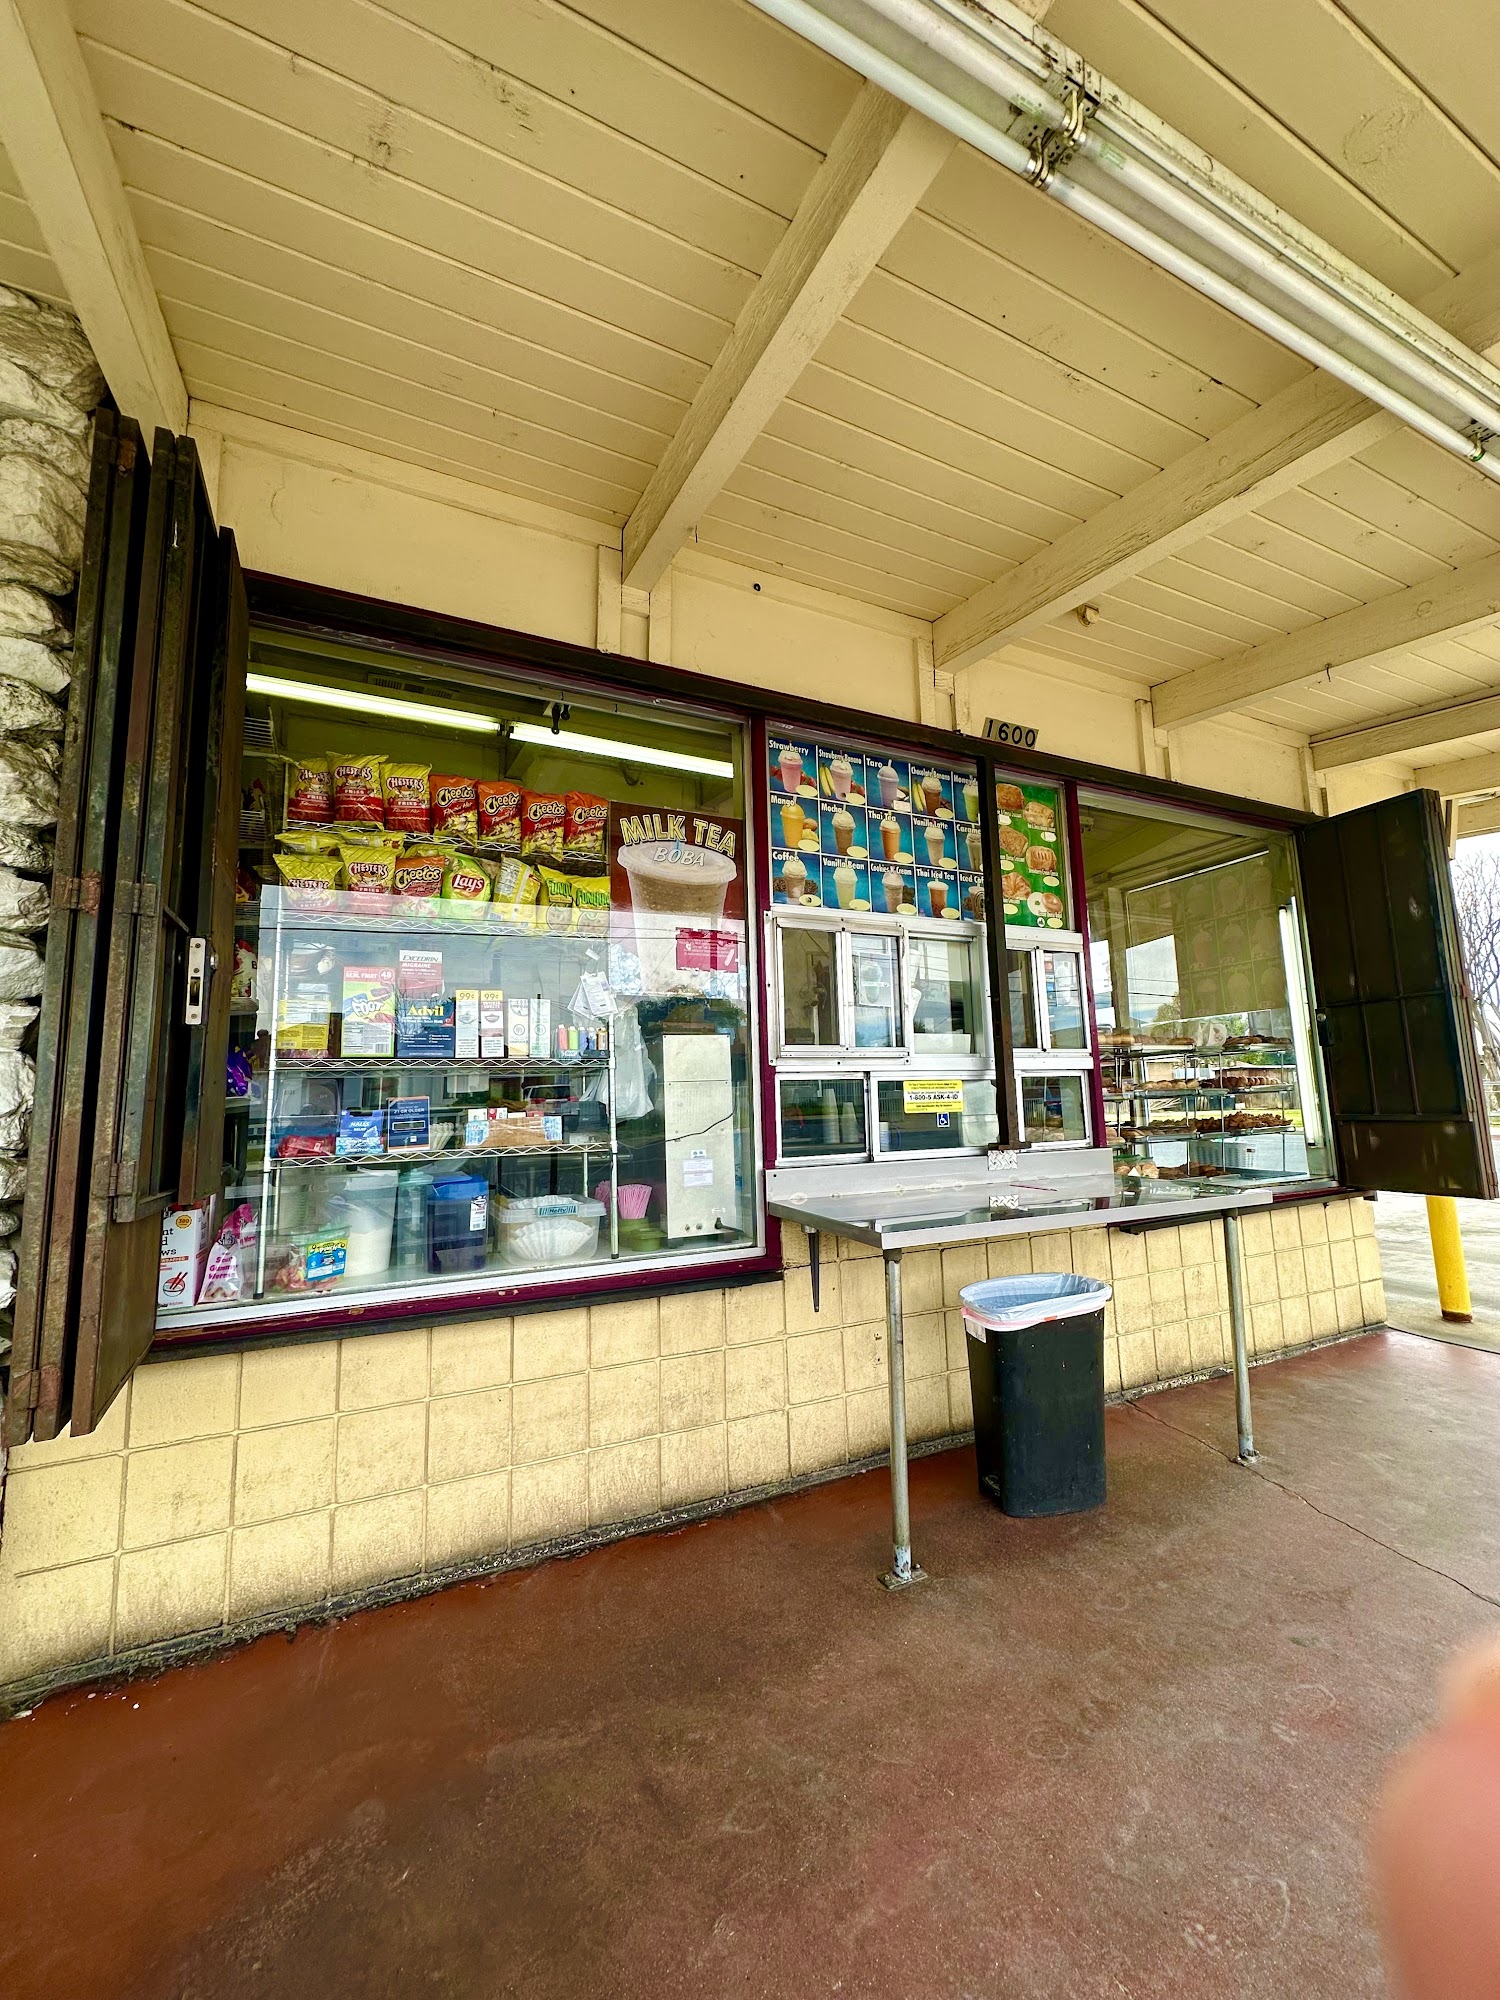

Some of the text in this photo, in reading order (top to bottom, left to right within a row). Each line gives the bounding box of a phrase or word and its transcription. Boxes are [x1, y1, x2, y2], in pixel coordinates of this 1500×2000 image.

[986, 719, 1036, 749] 1600
[769, 740, 809, 756] Strawberry
[866, 758, 883, 769] Taro
[386, 776, 425, 794] CHESTER'S
[436, 785, 476, 807] Cheetos
[771, 795, 795, 807] Mango
[527, 801, 566, 823] Cheetos
[821, 803, 843, 813] Mocha
[573, 806, 608, 825] Cheetos
[869, 811, 884, 820] Thai
[913, 818, 949, 830] Vanilla Latte
[956, 824, 981, 835] Carame
[619, 813, 737, 860] MILK TEA
[653, 845, 706, 868] BOBA
[772, 851, 800, 862] Coffee
[822, 857, 865, 870] Vanilla Bean
[348, 862, 390, 881] CHESTER'S
[394, 865, 441, 890] Cheetos
[897, 867, 912, 876] Cream
[916, 868, 955, 881] Thai Iced Tea
[960, 873, 972, 883] Iced
[380, 971, 392, 979] 48
[459, 992, 475, 1000] 99¢
[352, 999, 384, 1017] FOOT
[406, 1003, 444, 1017] Advil
